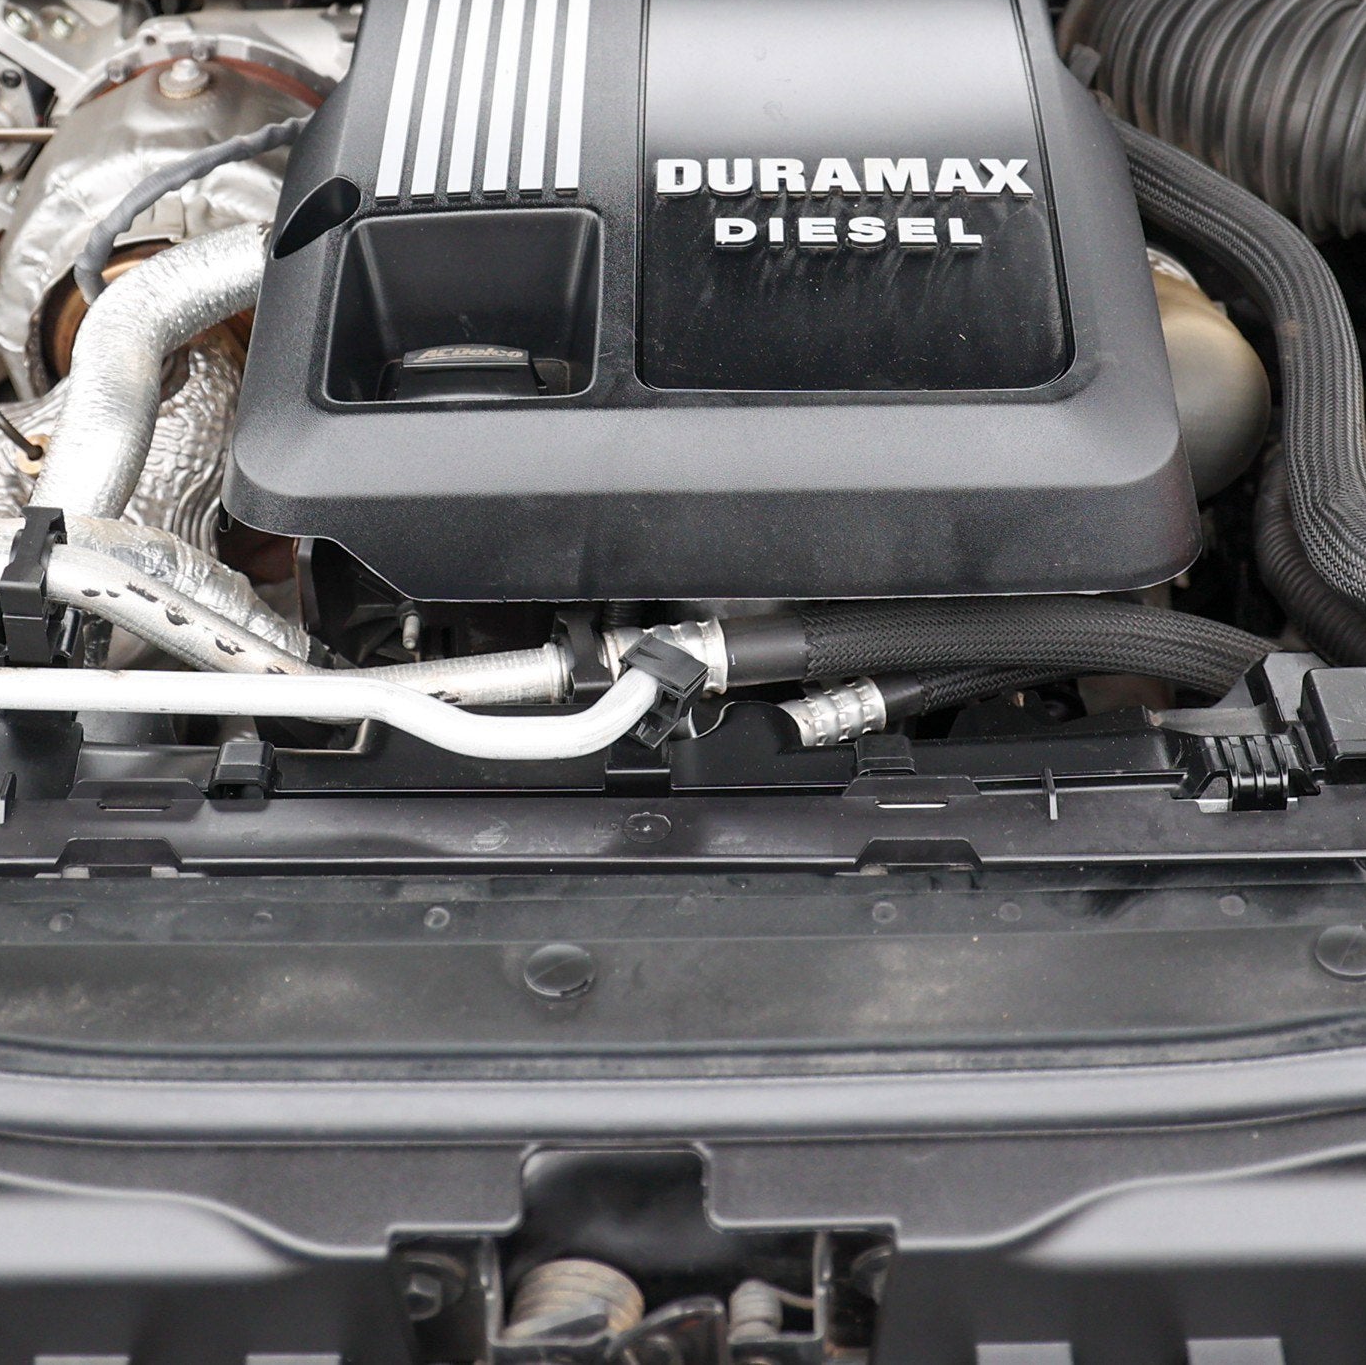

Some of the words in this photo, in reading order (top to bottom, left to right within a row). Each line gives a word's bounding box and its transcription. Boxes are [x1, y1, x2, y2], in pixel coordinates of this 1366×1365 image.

[656, 157, 1034, 196] DURAMAX
[715, 216, 983, 248] DIESEL
[414, 347, 524, 363] ACDelco
